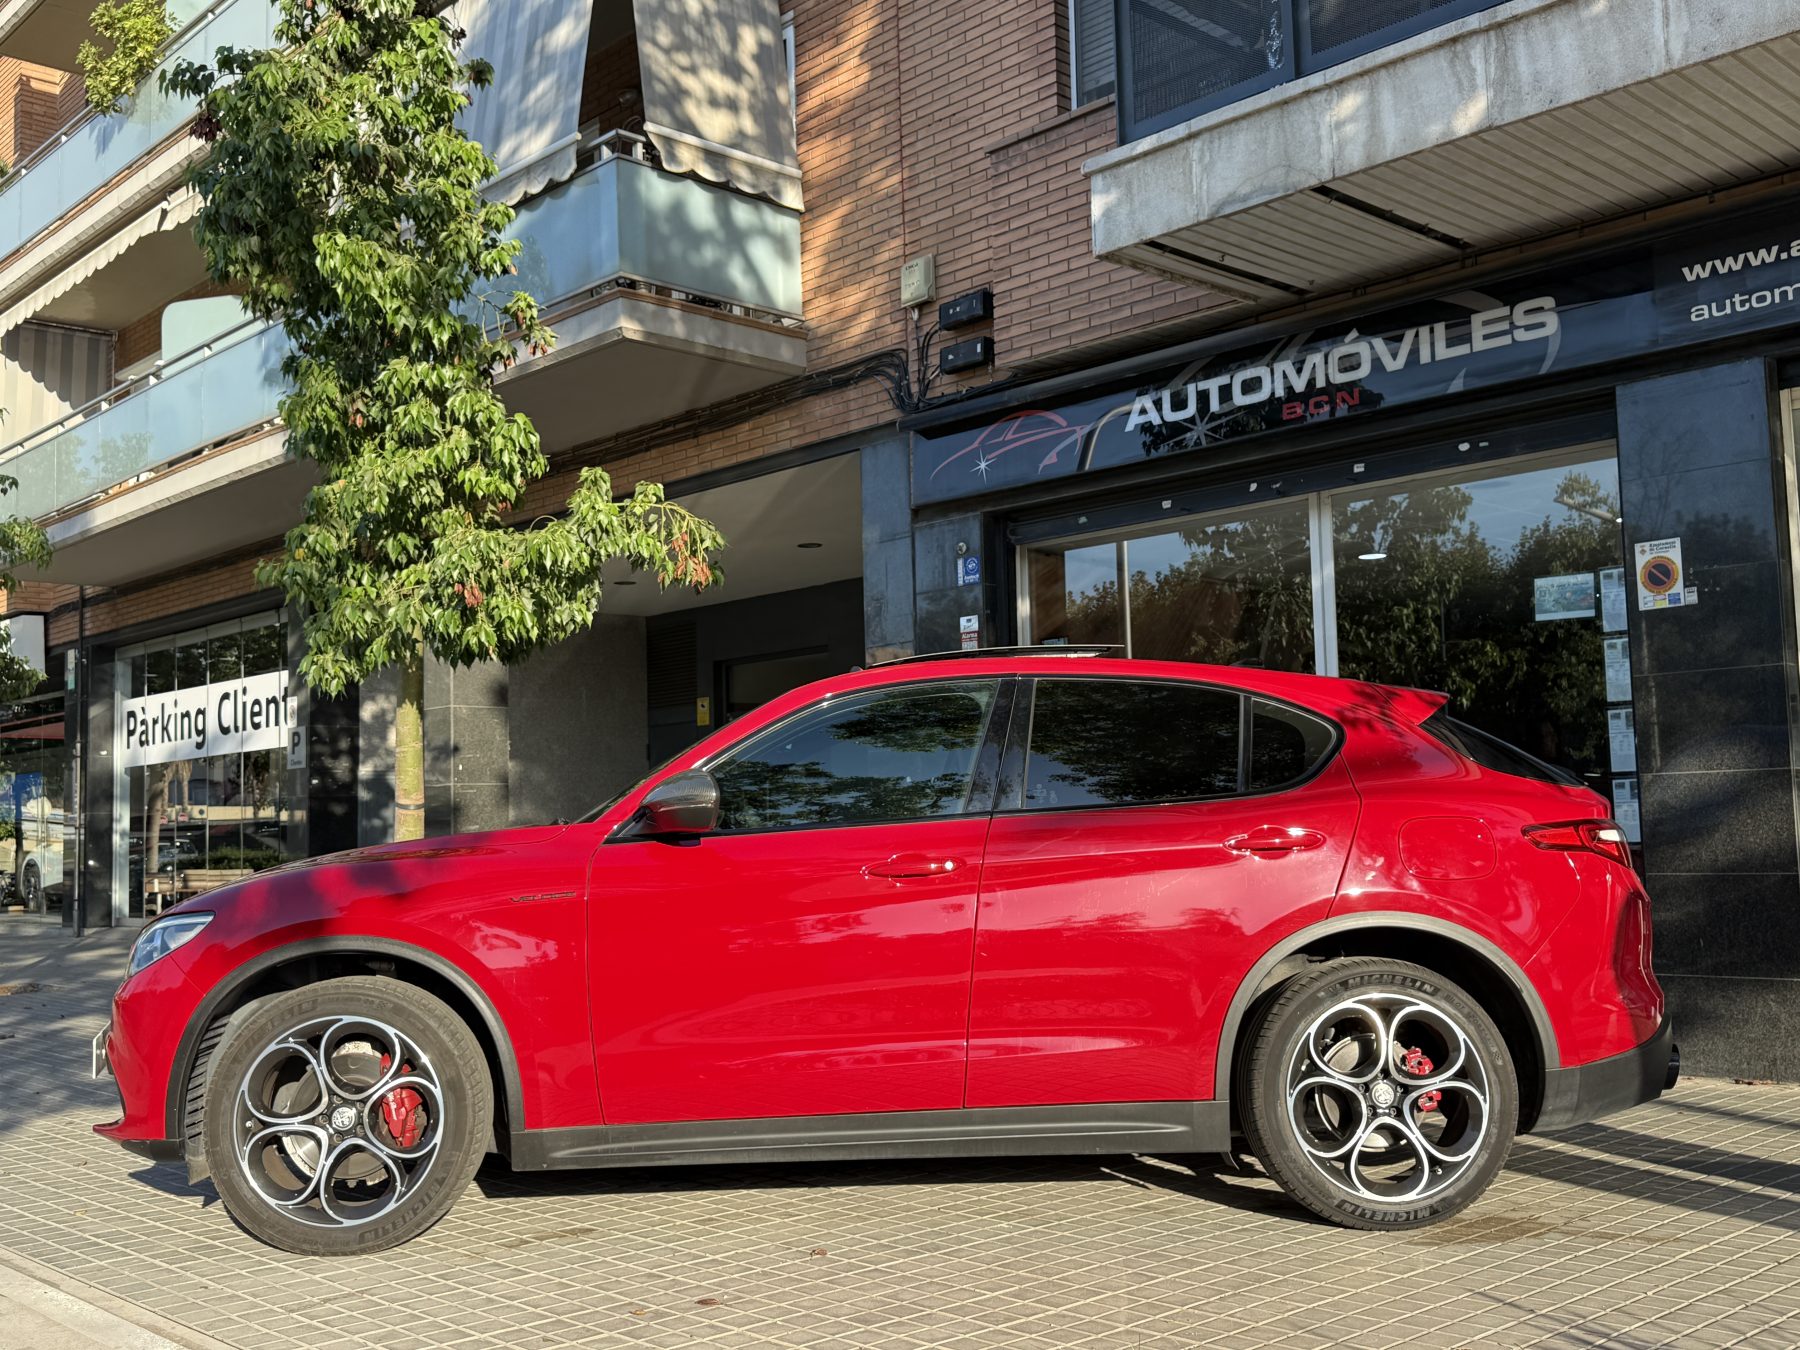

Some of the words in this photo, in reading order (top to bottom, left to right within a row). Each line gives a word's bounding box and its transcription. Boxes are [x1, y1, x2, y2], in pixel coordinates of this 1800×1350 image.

[1124, 296, 1559, 432] AUTOMÓVILES
[1282, 387, 1361, 421] BCN
[127, 698, 207, 750] Pàrking
[292, 731, 301, 755] P
[1348, 974, 1435, 994] MICHELIN
[1341, 1203, 1431, 1222] MICHELIN
